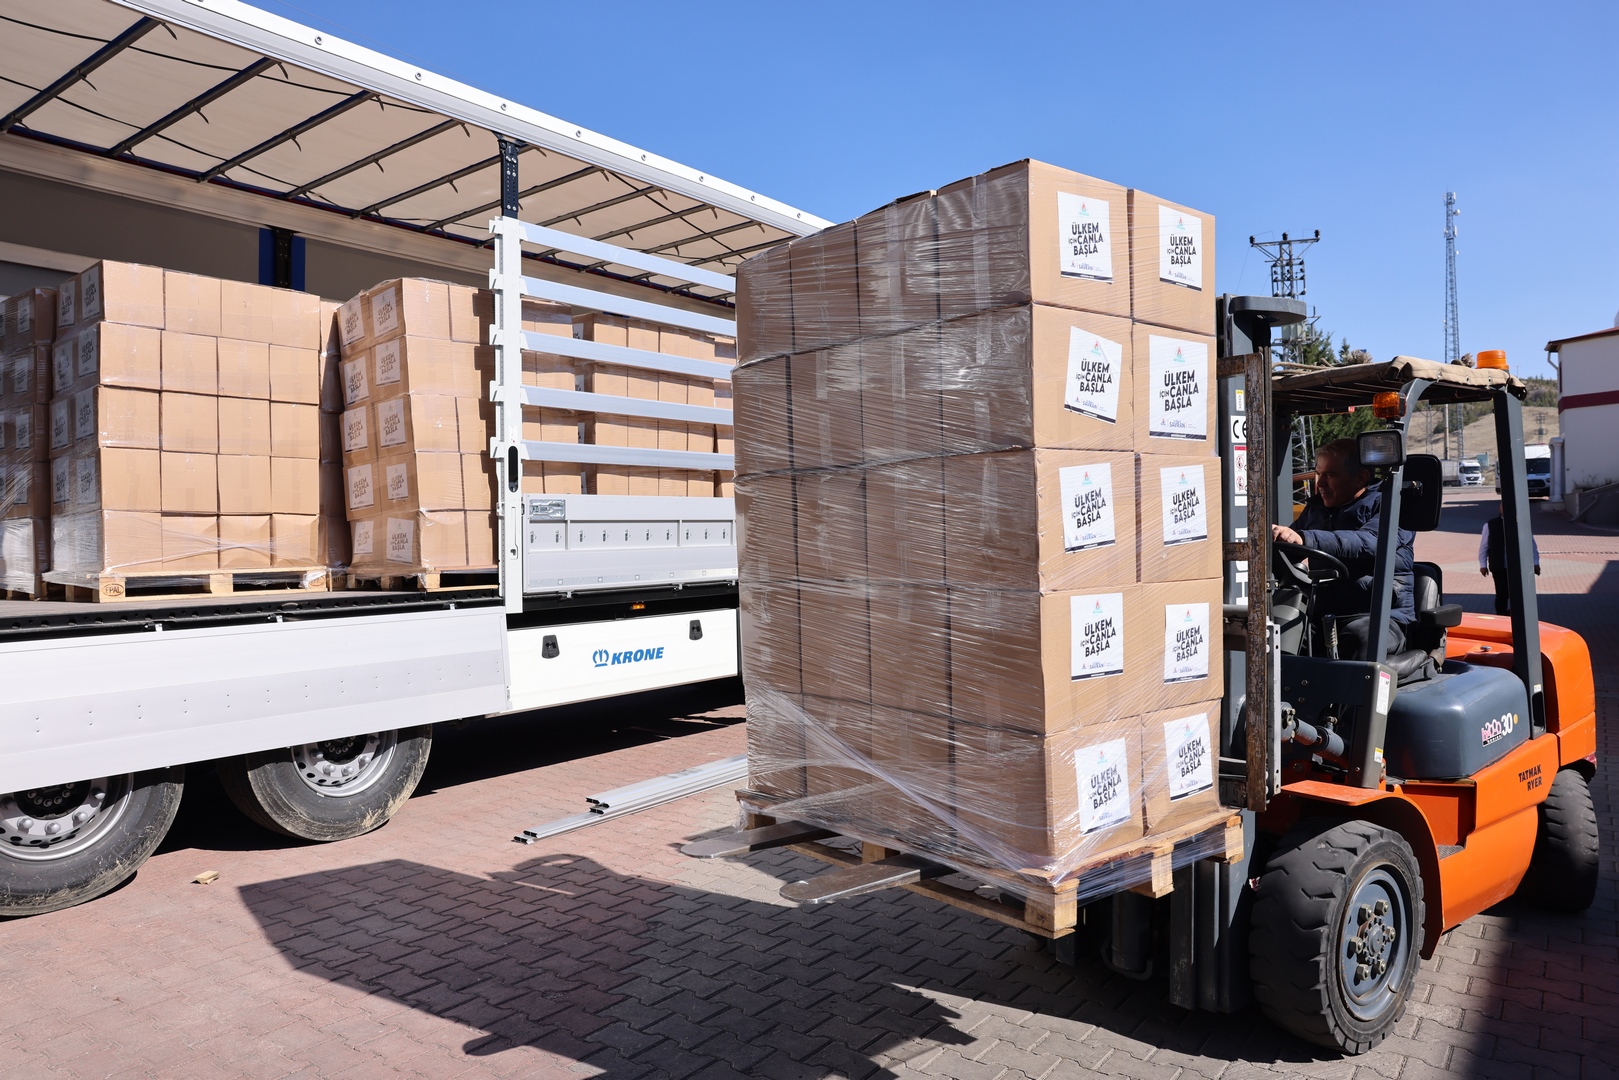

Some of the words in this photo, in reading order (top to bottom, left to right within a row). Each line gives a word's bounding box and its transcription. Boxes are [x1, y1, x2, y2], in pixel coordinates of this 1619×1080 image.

[1072, 222, 1099, 235] ÜLKEM
[1078, 233, 1104, 244] CANLA
[1170, 234, 1193, 246] ÜLKEM
[1074, 244, 1098, 258] BAŞLA
[1174, 246, 1196, 256] CANLA
[1171, 256, 1192, 268] BAŞLA
[1081, 358, 1110, 373] ÜLKEM
[1086, 373, 1112, 383] CANLA
[1164, 370, 1195, 387] ÜLKEM
[1080, 382, 1105, 395] BAŞLA
[1170, 382, 1199, 398] CANLA
[1165, 396, 1192, 413] BAŞLA
[1074, 486, 1102, 508] ÜLKEM
[1173, 487, 1196, 505] ÜLKEM
[1178, 496, 1200, 512] CANLA
[1081, 497, 1106, 516] CANLA
[1077, 510, 1101, 528] BAŞLA
[1174, 508, 1195, 524] BAŞLA
[1084, 616, 1112, 637] ÜLKEM
[1176, 625, 1200, 643] ÜLKEM
[1090, 626, 1116, 645] CANLA
[1181, 634, 1203, 650] CANLA
[611, 646, 664, 665] KRONE
[1085, 639, 1110, 657] BAŞLA
[1176, 646, 1198, 662] BAŞLA
[1501, 712, 1513, 736] 30
[1184, 745, 1206, 765] CANLA
[1091, 764, 1117, 788] ÜLKEM
[1181, 758, 1201, 777] BAŞLA
[1518, 764, 1542, 782] TATMAK
[1097, 774, 1122, 796] CANLA
[1527, 776, 1542, 791] RYER
[1093, 788, 1117, 810] BAŞLA
